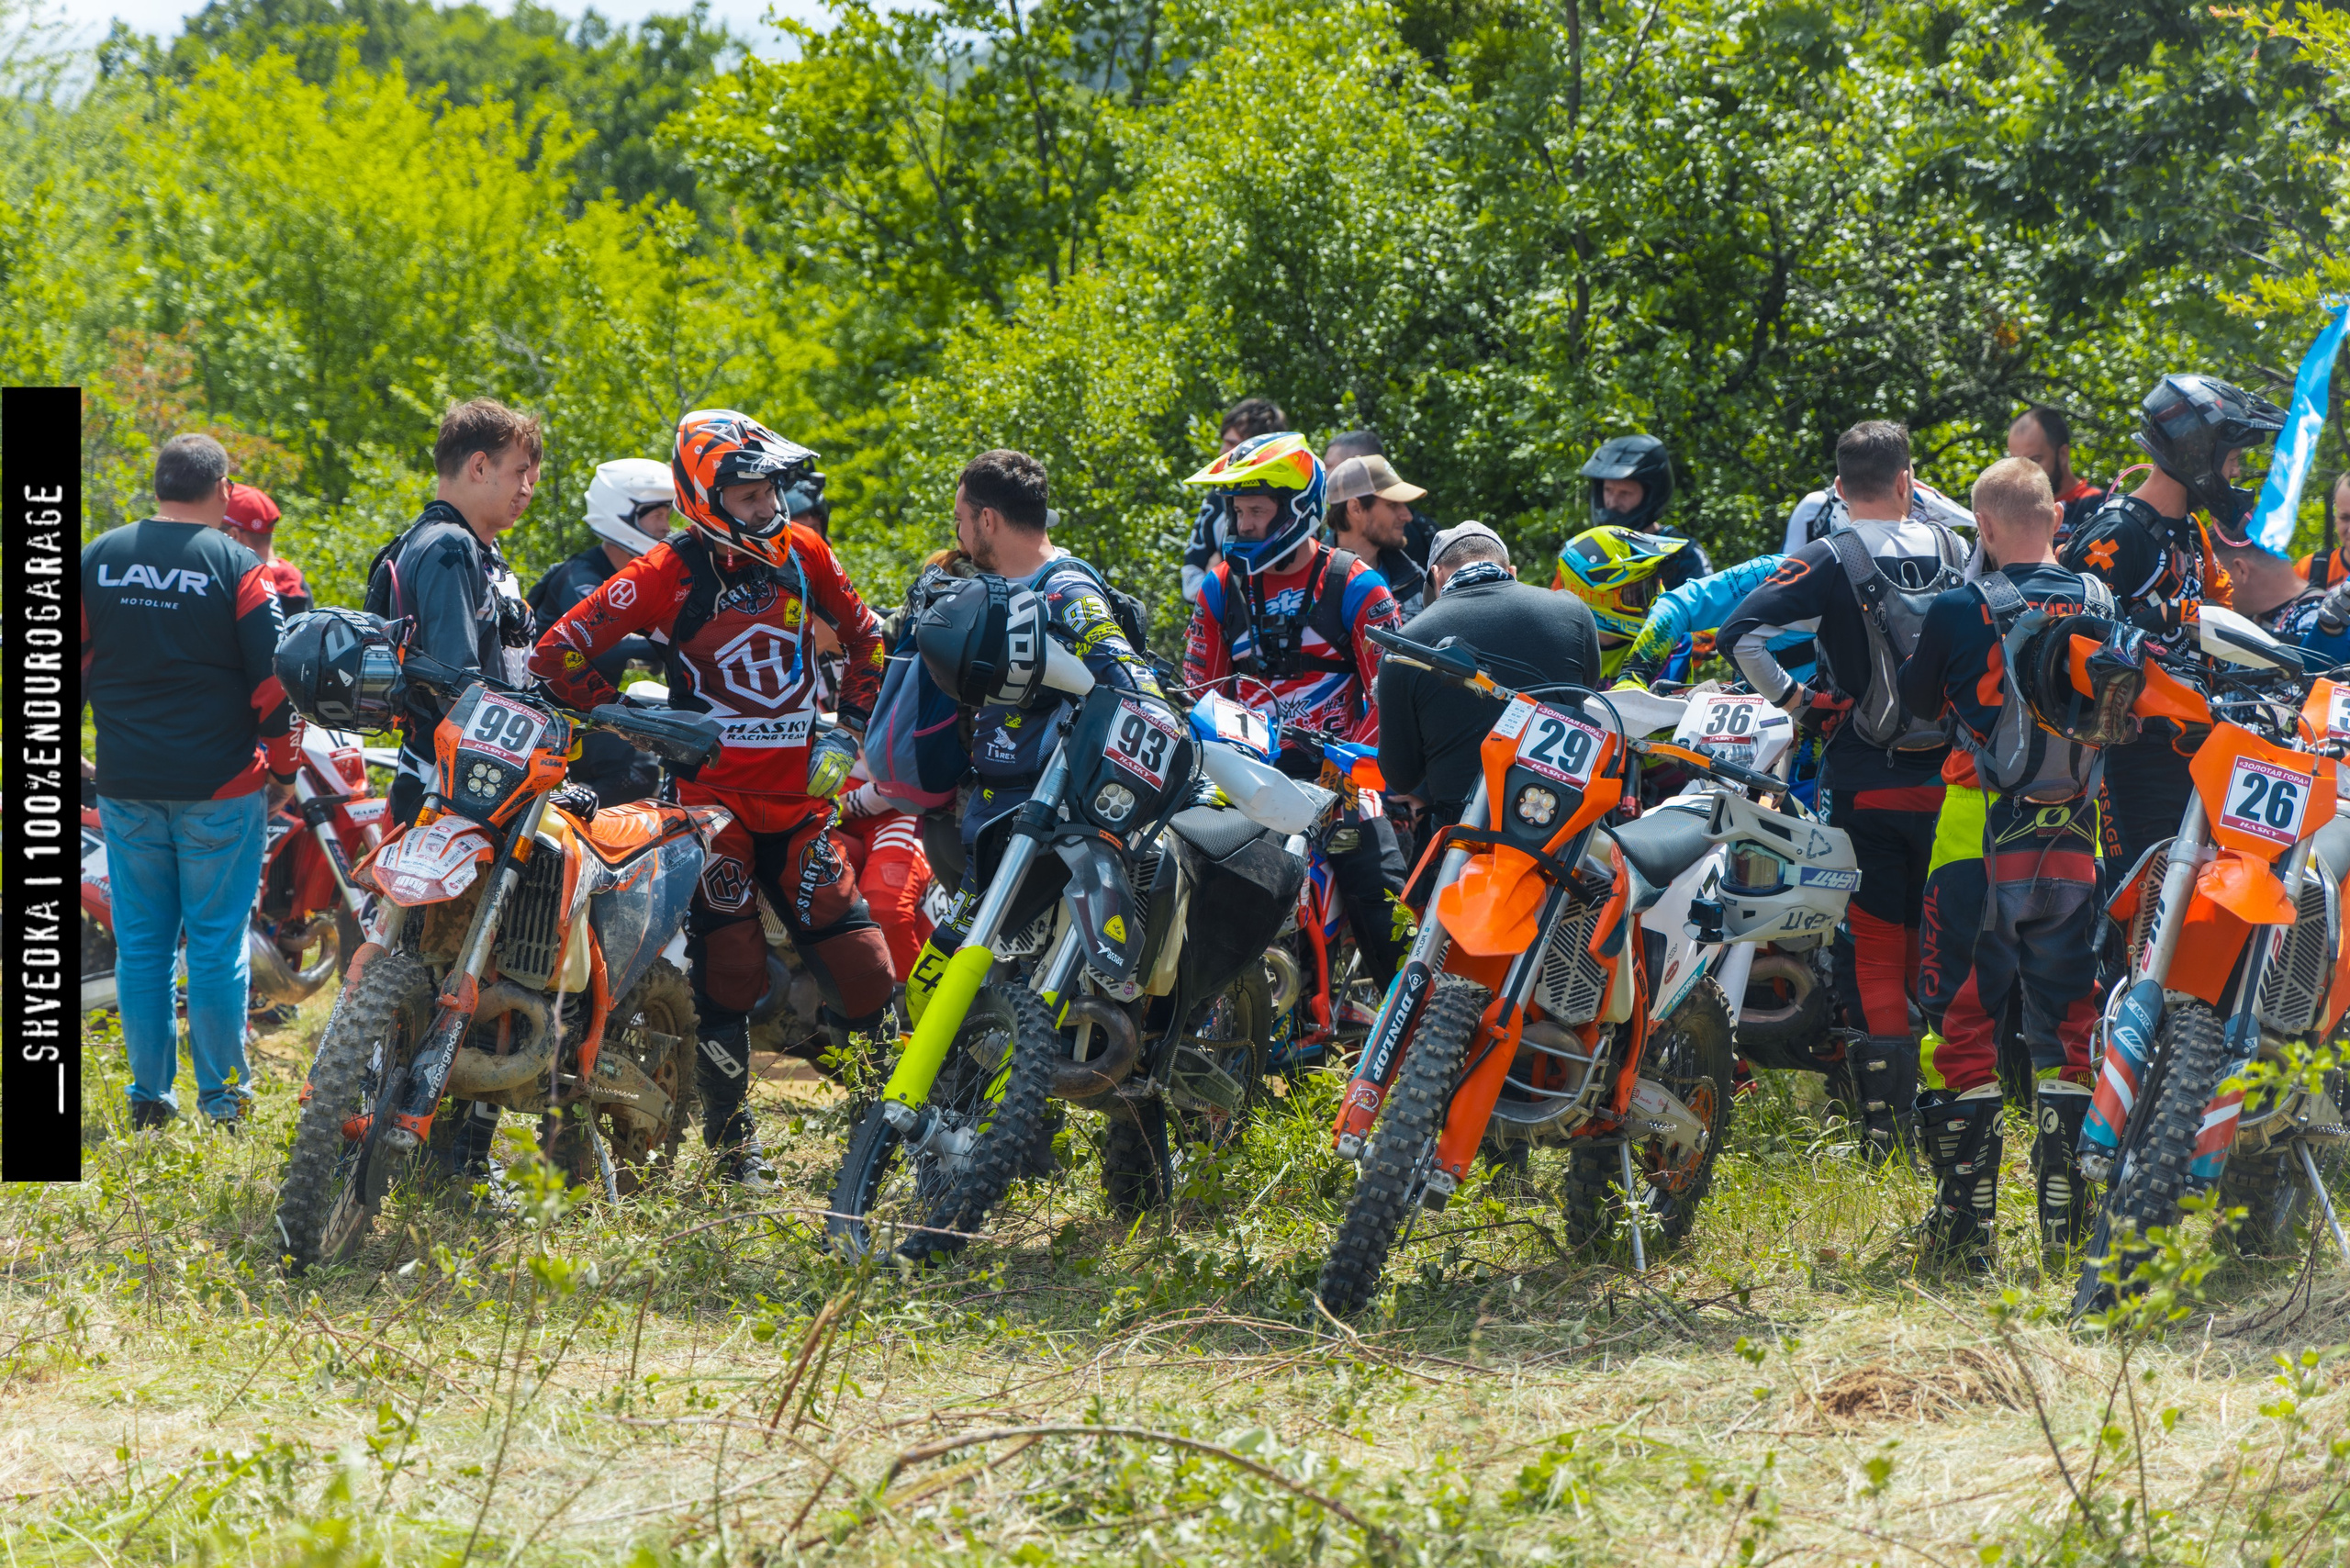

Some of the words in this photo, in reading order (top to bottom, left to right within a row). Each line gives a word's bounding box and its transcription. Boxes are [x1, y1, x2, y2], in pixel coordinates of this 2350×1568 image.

[97, 564, 211, 597] LAVR
[1570, 582, 1606, 607] EATT
[119, 597, 180, 610] MOTOLINE
[484, 696, 523, 712] «ЗОЛОТАЯ
[522, 707, 545, 724] ГОРА»
[1741, 697, 1763, 705] ГОРА»
[474, 704, 534, 753] 99
[726, 720, 809, 734] HASKY
[1124, 700, 1158, 725] «ЗОЛОТАЯ
[1158, 721, 1179, 738] ГОРА»
[1235, 712, 1249, 740] 1
[1538, 707, 1581, 727] «ЗОЛОТАЯ
[1580, 722, 1604, 740] ГОРА»
[1706, 703, 1753, 735] 36
[474, 743, 511, 757] HASKY
[1117, 714, 1168, 773] 93
[1528, 718, 1593, 775] 29
[540, 758, 563, 768] KTM
[1118, 756, 1151, 778] HASKY
[1531, 763, 1571, 781] HASKY
[2239, 761, 2282, 777] «ЗОЛОТАЯ
[2282, 772, 2309, 785] ГОРА»
[2235, 772, 2298, 829] 26
[2239, 822, 2280, 837] HASKY
[796, 861, 822, 911] START
[1672, 972, 1698, 1007] MOTOREX
[1371, 992, 1415, 1082] DUNLOP
[428, 1020, 464, 1099] erzbergrodeo
